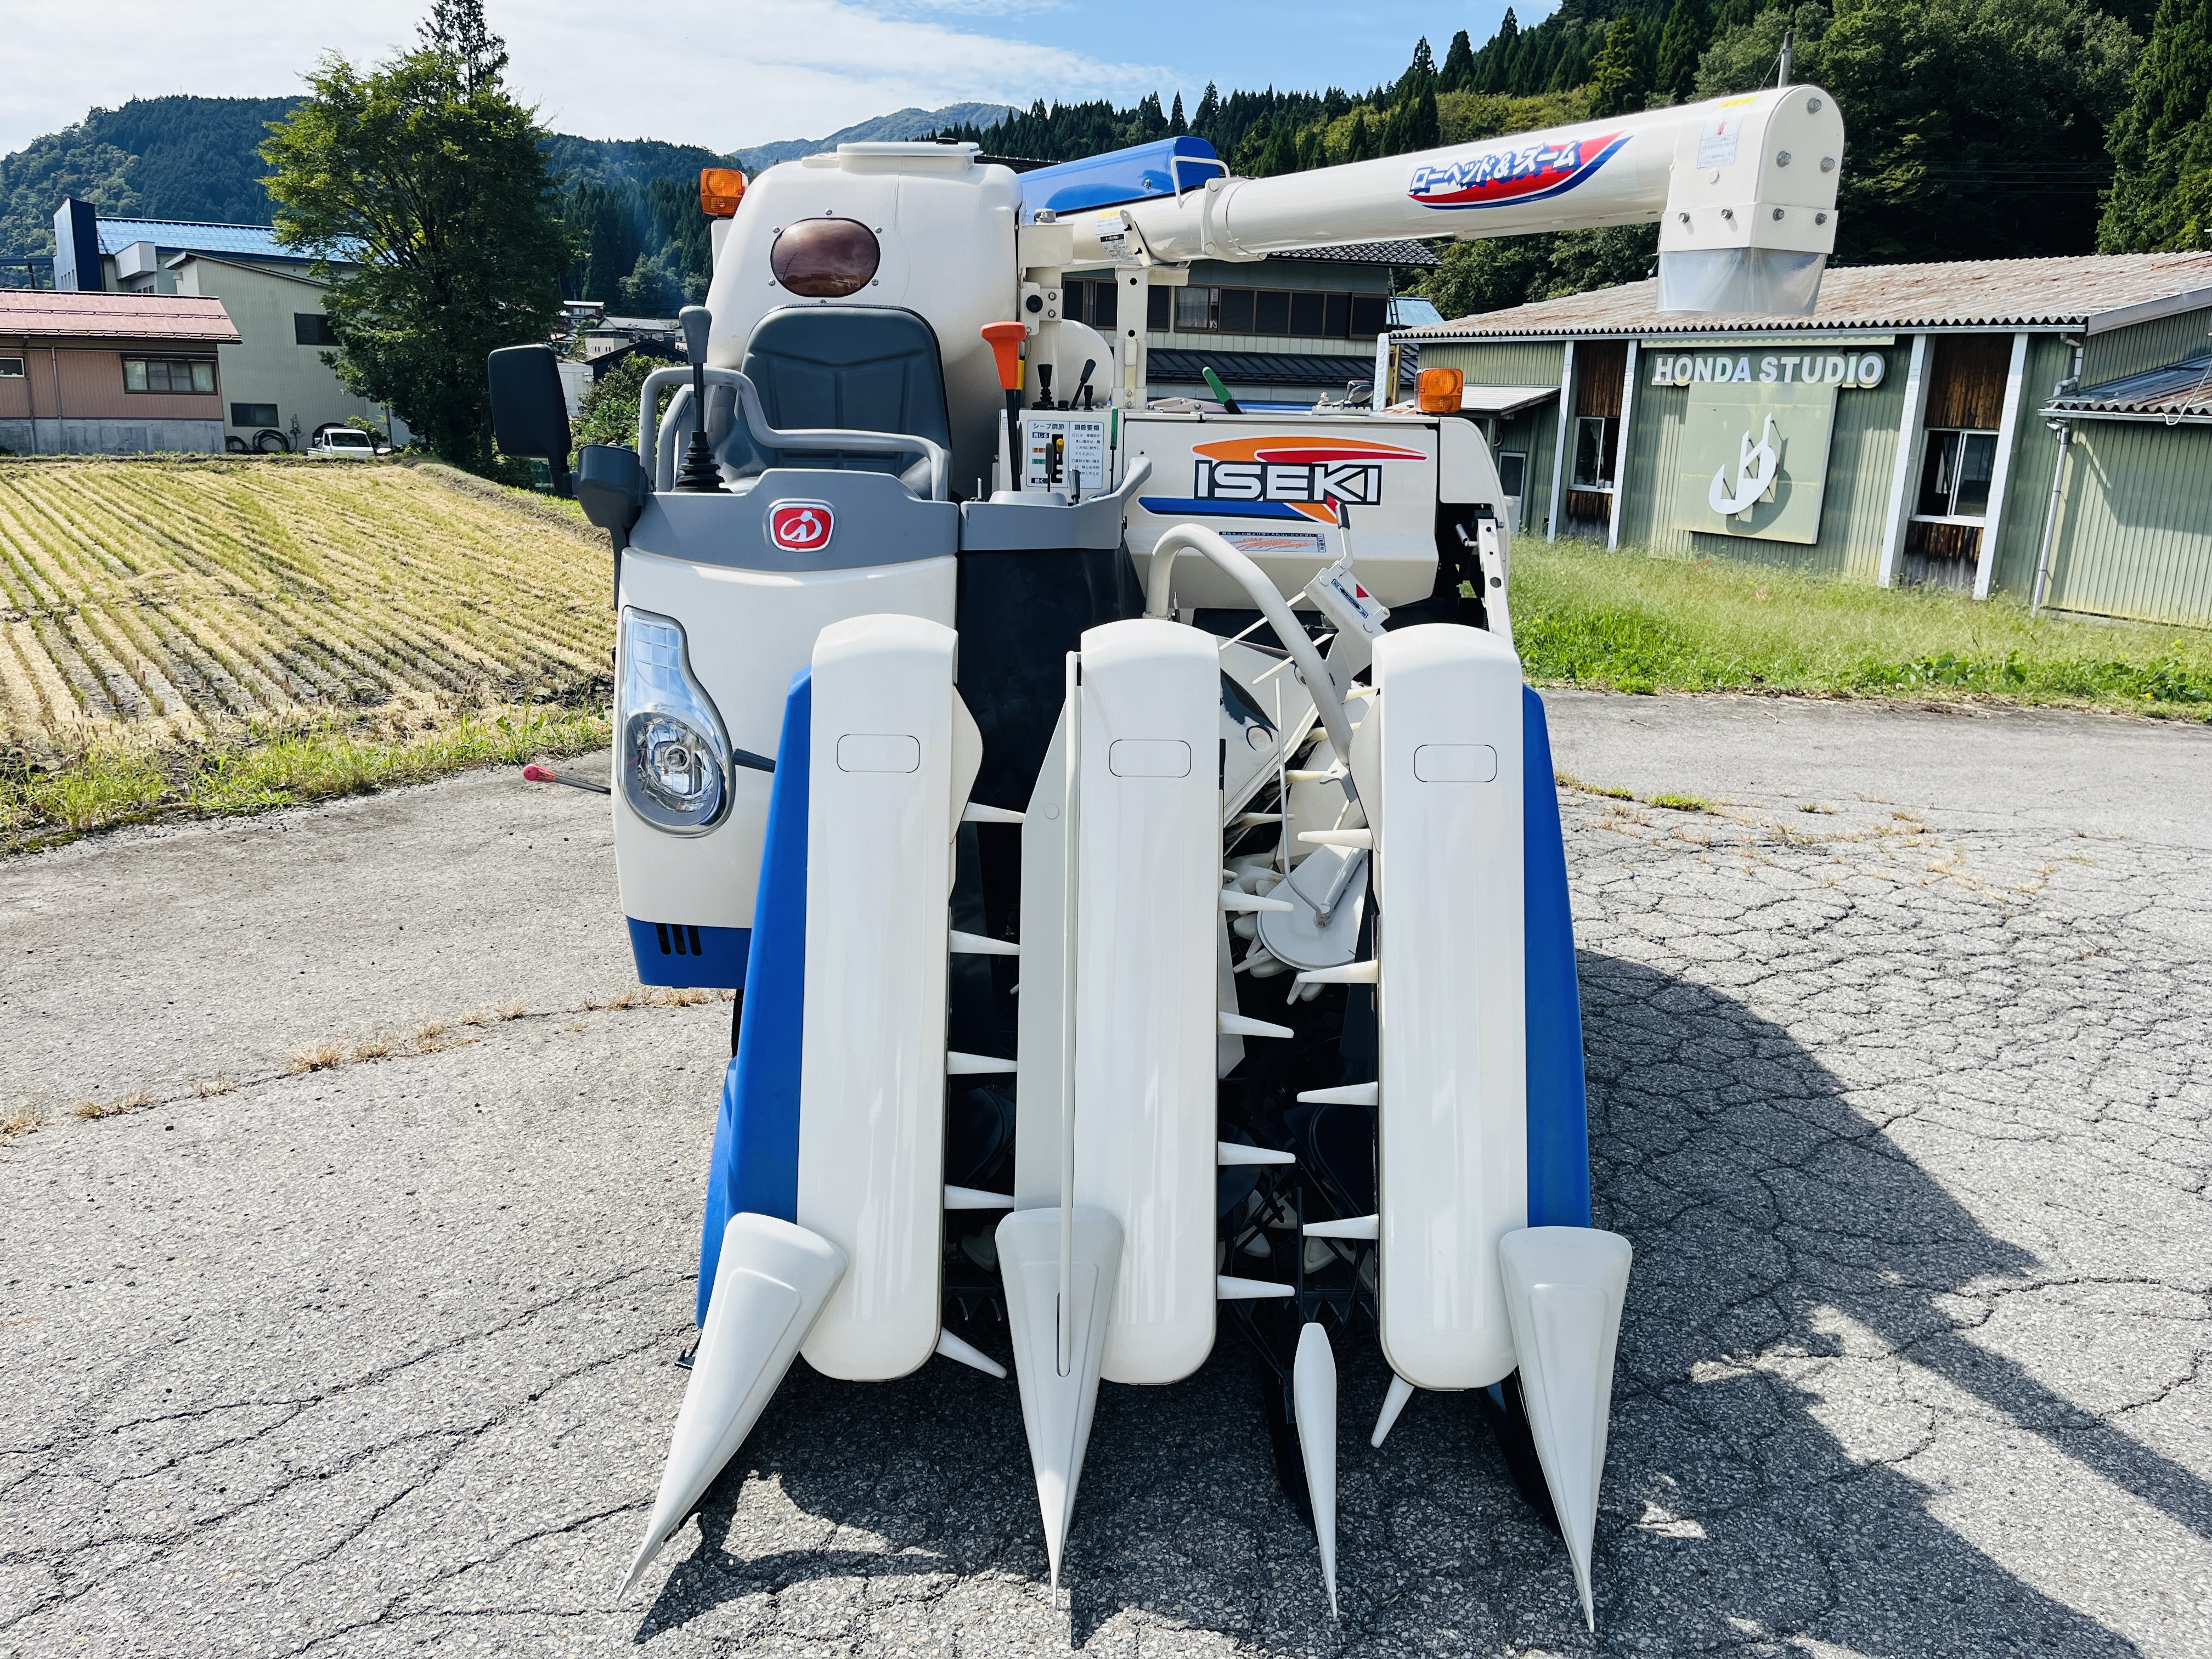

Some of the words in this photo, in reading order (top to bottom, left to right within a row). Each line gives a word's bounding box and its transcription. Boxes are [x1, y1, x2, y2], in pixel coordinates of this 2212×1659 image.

[1654, 354, 1752, 385] HONDA
[1758, 354, 1884, 386] STUDIO
[1194, 460, 1383, 506] ISEKI
